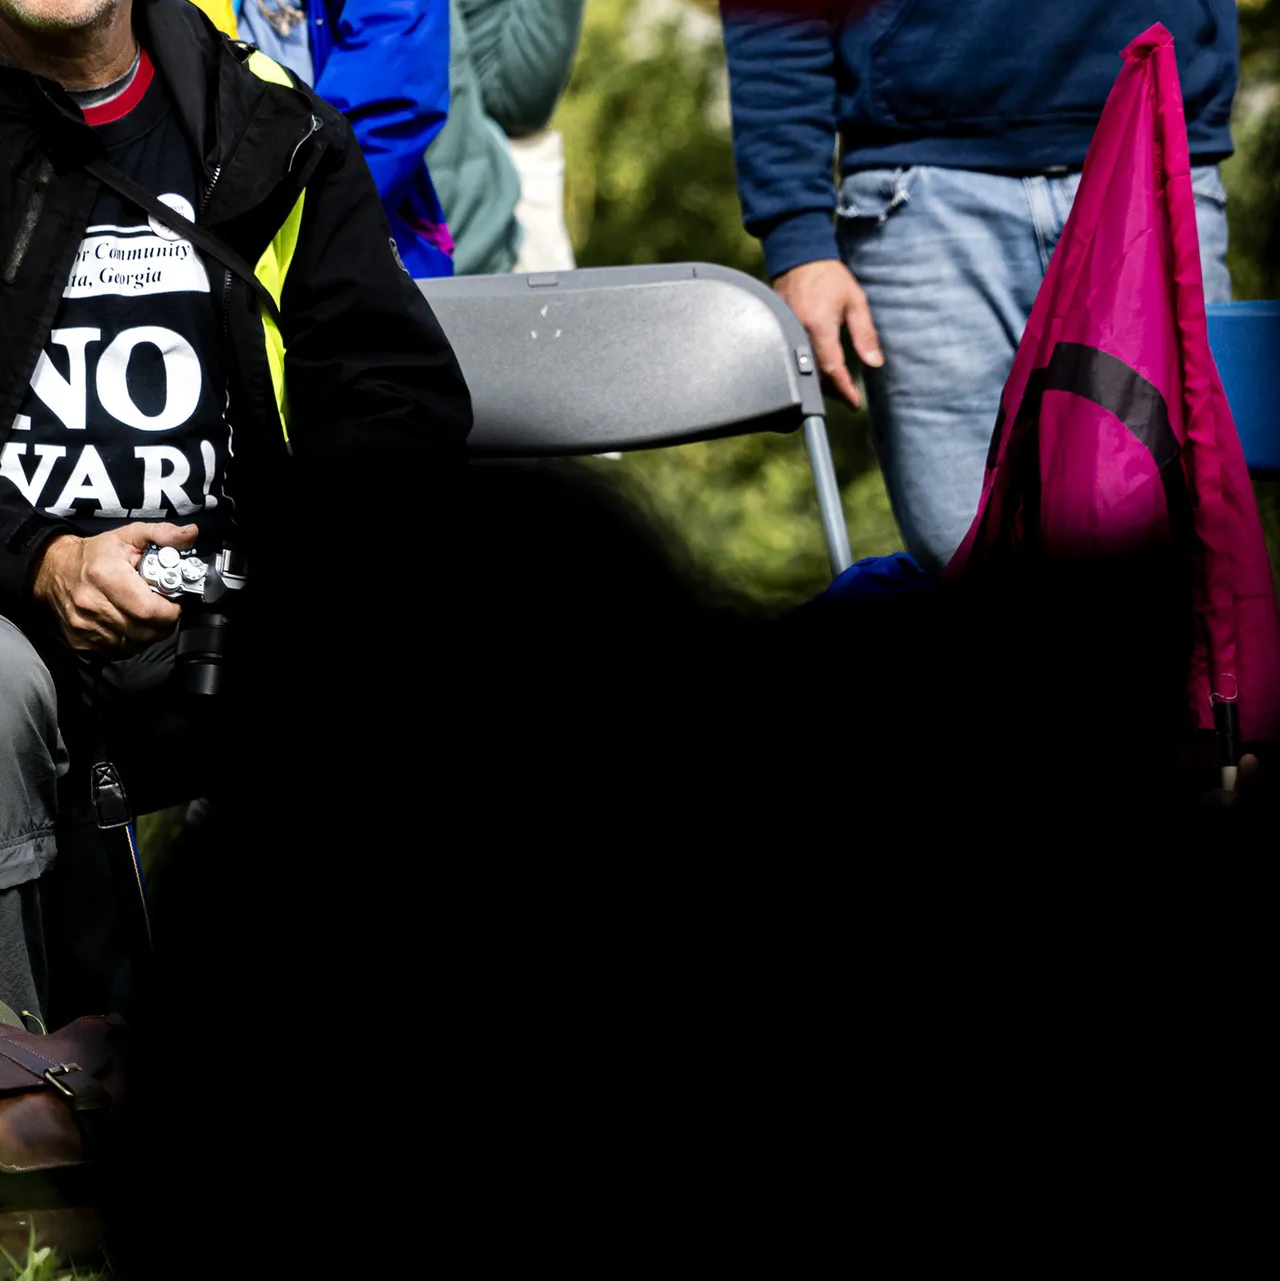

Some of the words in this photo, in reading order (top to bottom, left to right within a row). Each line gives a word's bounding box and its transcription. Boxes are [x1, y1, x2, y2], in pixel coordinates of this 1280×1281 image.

[94, 241, 191, 266] Community
[99, 265, 163, 290] Georgia
[11, 324, 203, 432] NO
